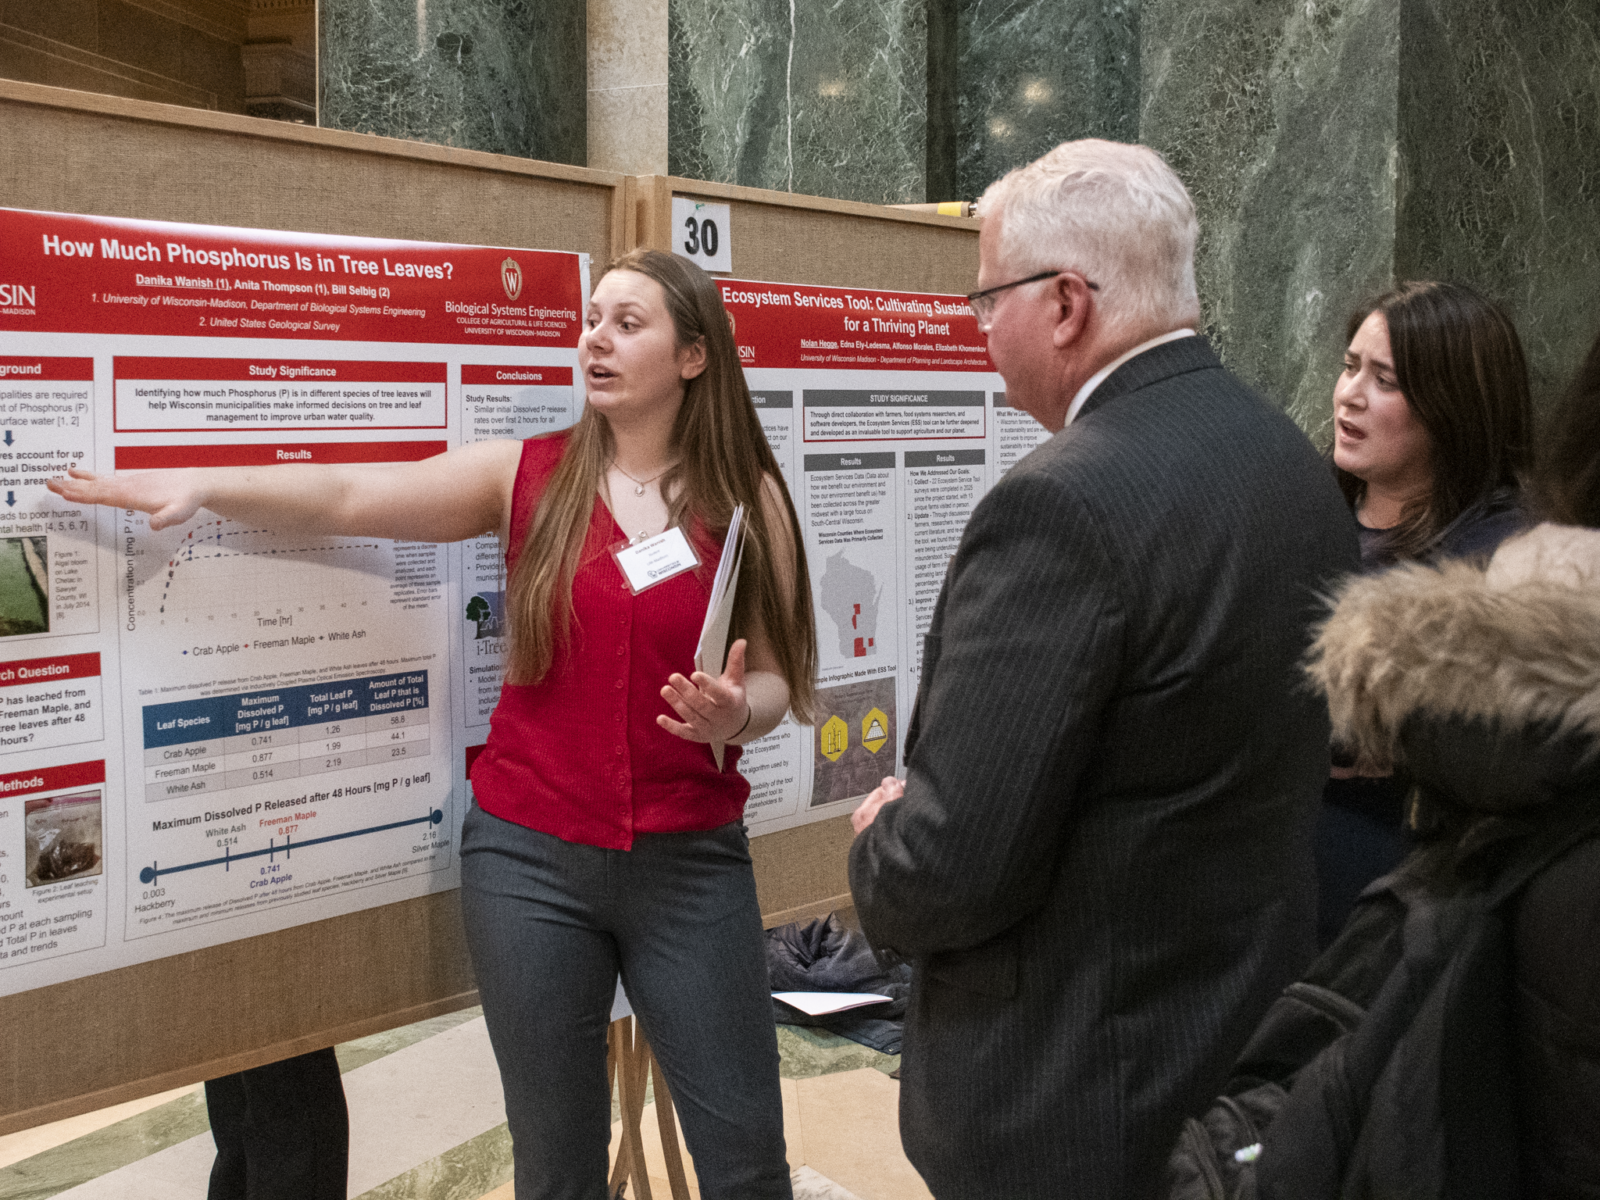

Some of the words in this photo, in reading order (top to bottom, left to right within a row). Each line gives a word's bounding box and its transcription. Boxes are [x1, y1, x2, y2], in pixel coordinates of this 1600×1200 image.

[685, 217, 718, 256] 30
[43, 234, 94, 257] How
[100, 238, 161, 261] Much
[166, 243, 291, 270] Phosphorus
[295, 252, 312, 271] Is
[317, 254, 335, 272] in
[338, 255, 378, 275] Tree
[383, 258, 453, 279] Leaves?
[136, 274, 173, 286] Danika
[174, 276, 214, 288] Wanish
[216, 278, 232, 290] (1),
[234, 280, 260, 290] Anita
[262, 281, 312, 294] Thompson
[315, 284, 329, 296] (1),
[332, 285, 346, 294] Bill
[349, 286, 376, 298] Selbig
[379, 287, 390, 299] (2)
[506, 272, 517, 292] W
[103, 294, 148, 306] University
[151, 296, 161, 305] of
[162, 296, 248, 310] Wisconsin-Madison,
[251, 300, 298, 311] Department
[300, 303, 308, 311] of
[310, 303, 348, 314] Biological
[349, 304, 381, 315] Systems
[383, 306, 425, 318] Engineering
[722, 287, 791, 308] Ecosystem
[794, 292, 844, 309] Services
[845, 295, 873, 310] Tool:
[876, 297, 933, 317] Cultivating
[446, 301, 489, 316] Biological
[492, 304, 526, 316] Systems
[529, 306, 576, 321] Engineering
[210, 318, 238, 327] United
[240, 318, 266, 328] States
[268, 320, 311, 331] Geological
[313, 321, 340, 332] Survey
[844, 316, 859, 331] for
[863, 321, 869, 332] a
[872, 318, 915, 337] Thriving
[918, 320, 950, 335] Planet
[801, 339, 818, 348] Nolan
[840, 340, 854, 348] Edna
[856, 341, 891, 350] Ely-Ledesma,
[914, 344, 934, 352] Morales,
[249, 365, 277, 378] Study
[280, 366, 336, 378] Significance
[496, 371, 542, 380] Conclusions
[135, 388, 181, 398] Identifying
[203, 389, 226, 397] much
[229, 389, 276, 399] Phosphorus
[279, 389, 289, 399] (P)
[310, 390, 340, 398] different
[343, 390, 370, 399] species
[372, 390, 380, 398] of
[396, 390, 418, 398] leaves
[420, 390, 431, 398] will
[466, 395, 484, 403] Study
[149, 401, 167, 410] help
[169, 401, 213, 409] Wisconsin
[216, 401, 271, 410] municipalities
[273, 401, 294, 409] make
[296, 401, 329, 409] informed
[332, 401, 366, 409] decisions
[206, 414, 258, 423] management
[271, 414, 301, 422] improve
[350, 413, 375, 421] quality.
[277, 450, 312, 459] Results
[936, 454, 955, 462] Results
[841, 458, 861, 466] Results
[127, 561, 135, 631] Concentration
[257, 617, 277, 627] Time
[280, 615, 292, 627] [hr]
[193, 647, 213, 656] Crab
[216, 644, 239, 655] Apple
[254, 640, 289, 649] Freeman
[291, 635, 315, 646] Maple
[328, 631, 349, 641] White
[352, 630, 366, 639] Ash
[18, 665, 69, 678] Question
[829, 672, 853, 681] Infographic
[7, 697, 23, 705] has
[27, 691, 62, 702] leached
[65, 690, 85, 698] from
[242, 695, 279, 706] Maximum
[310, 694, 328, 703] Total
[330, 691, 346, 700] Leaf
[348, 690, 352, 698] P
[42, 704, 71, 714] Maple,
[75, 700, 91, 710] and
[238, 706, 276, 718] Dissolved
[19, 721, 48, 730] leaves
[52, 717, 72, 725] after
[75, 714, 85, 722] 48
[157, 720, 176, 730] Leaf
[178, 716, 210, 728] Species
[1, 734, 34, 745] hours?
[164, 748, 182, 759] Crab
[185, 746, 206, 757] Apple
[252, 736, 272, 746] 0.741
[326, 725, 340, 734] 1.26
[391, 715, 405, 725] 58.8
[155, 766, 190, 778] Freeman
[192, 762, 215, 774] Maple
[252, 752, 272, 762] 0.877
[326, 742, 341, 750] 1.99
[391, 732, 405, 740] 44.1
[167, 784, 189, 794] White
[191, 781, 205, 790] Ash
[253, 770, 273, 780] 0.514
[326, 758, 341, 768] 2.19
[392, 748, 406, 756] 23.5
[153, 815, 201, 831] Maximum
[205, 804, 252, 822] Dissolved
[255, 803, 262, 813] P
[264, 794, 306, 810] Released
[310, 791, 330, 802] after
[332, 788, 342, 798] 48
[345, 785, 371, 796] Hours
[374, 781, 390, 793] [mg
[393, 778, 398, 788] P
[405, 777, 411, 787] g
[413, 772, 430, 784] leaf]
[259, 815, 293, 827] Freeman
[294, 810, 316, 822] Maple
[206, 827, 228, 837] White
[230, 824, 246, 833] Ash
[279, 825, 298, 835] 0.877
[217, 837, 238, 847] 0.514
[412, 844, 429, 854] Silver
[431, 840, 450, 850] Maple
[261, 865, 280, 875] 0.741
[250, 878, 268, 889] Crab
[270, 874, 292, 886] Apple
[143, 888, 165, 899] 0.003
[135, 899, 175, 913] Hackberry
